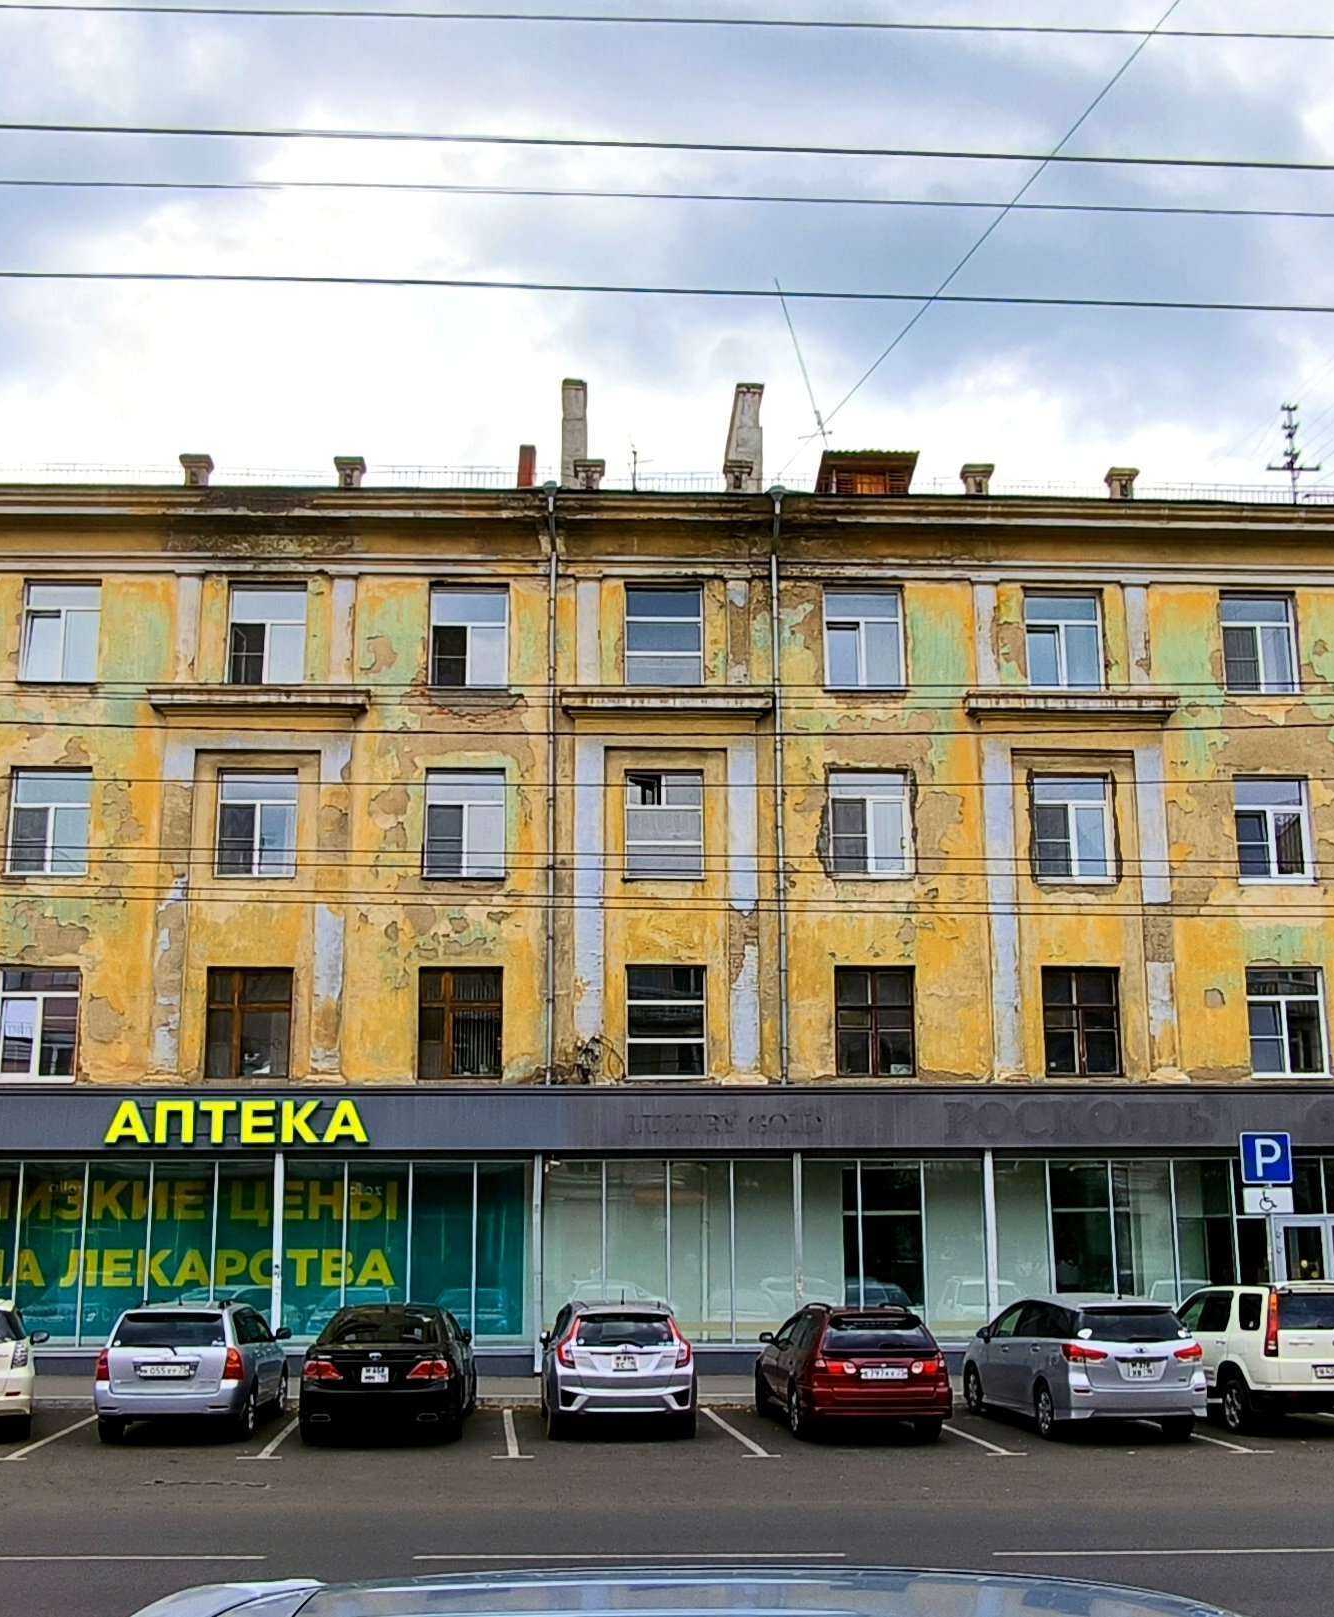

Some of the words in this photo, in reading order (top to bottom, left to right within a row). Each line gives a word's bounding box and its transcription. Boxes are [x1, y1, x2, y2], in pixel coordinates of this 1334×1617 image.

[104, 1099, 367, 1144] АПТЕКА
[1255, 1138, 1281, 1177] P
[230, 1180, 399, 1227] ЦЕНЫ
[59, 1249, 396, 1287] ЛЕКАРСТВА
